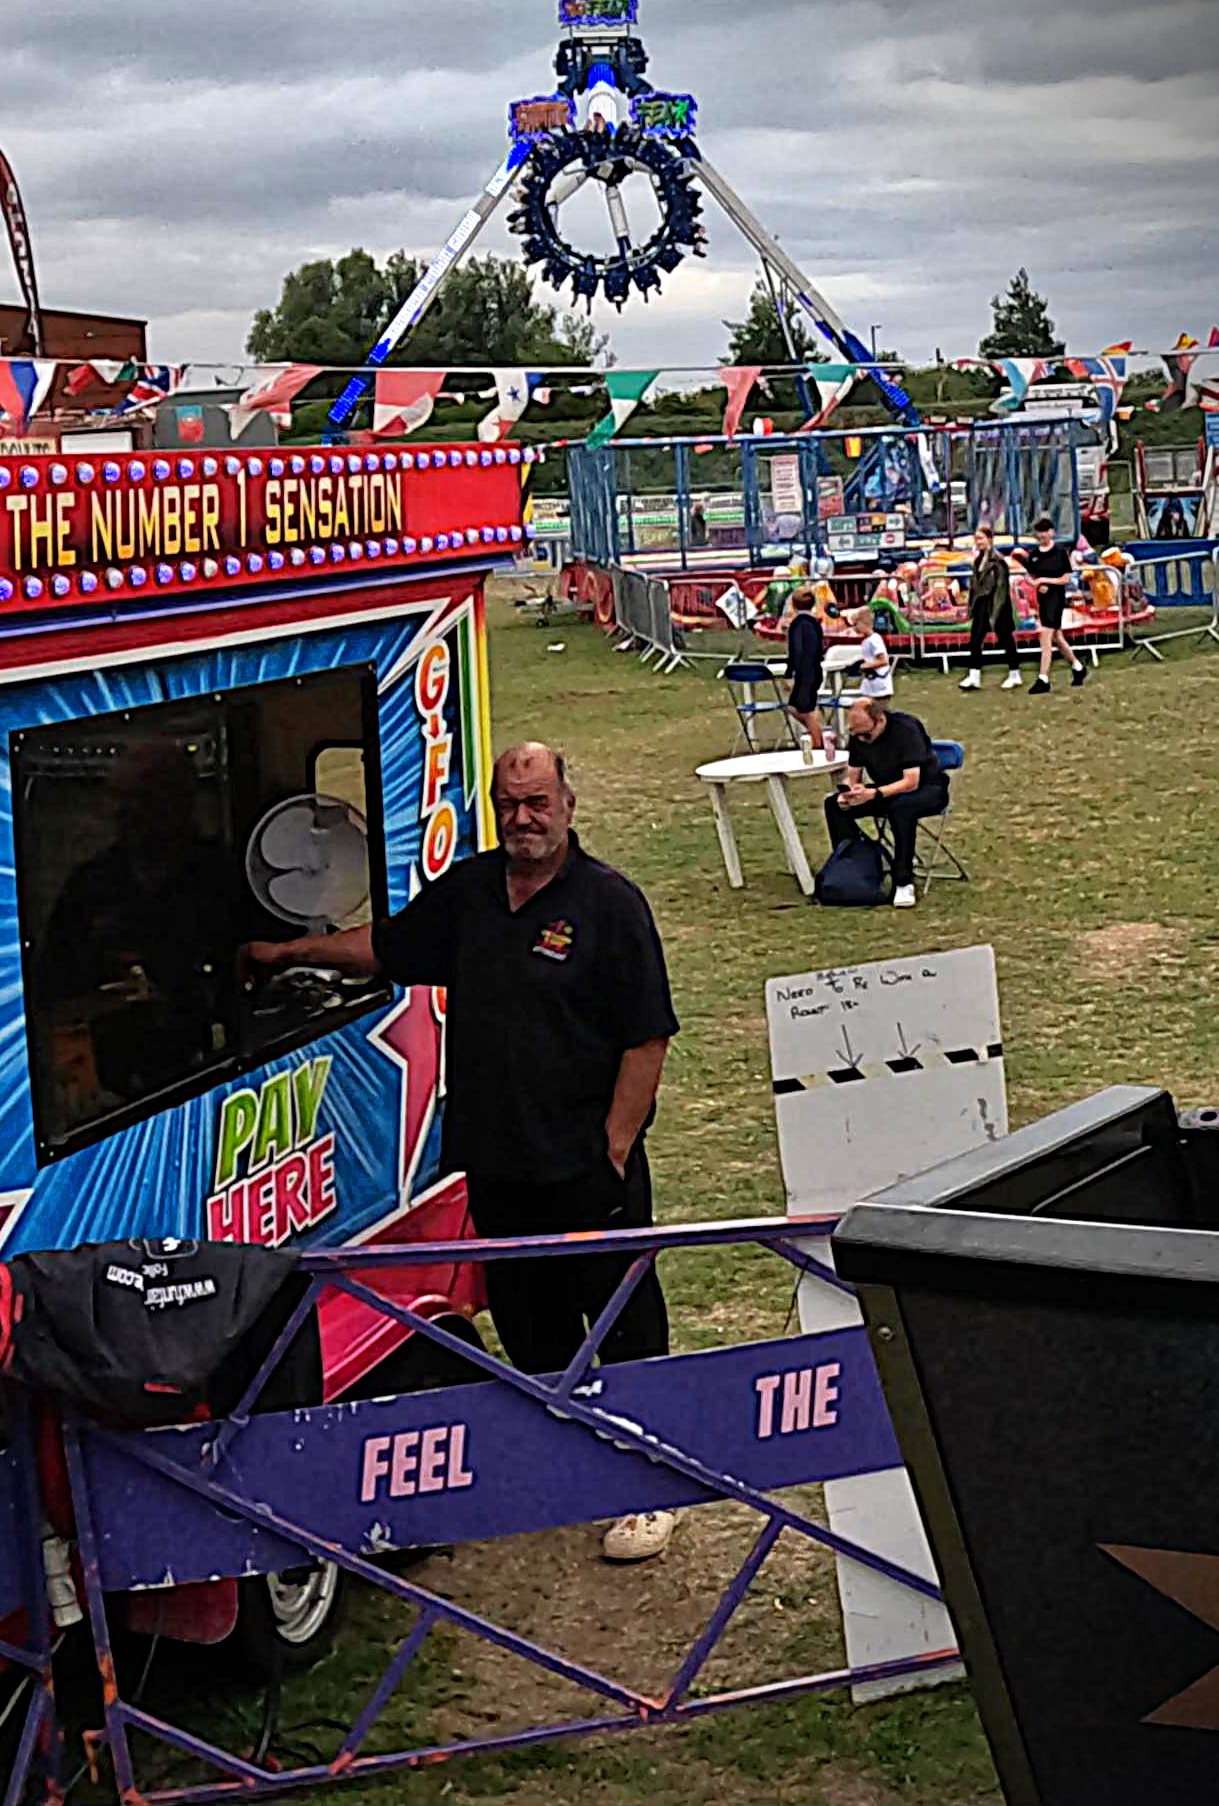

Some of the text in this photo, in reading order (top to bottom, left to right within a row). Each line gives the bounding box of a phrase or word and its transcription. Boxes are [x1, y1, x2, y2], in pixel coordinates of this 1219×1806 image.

[5, 469, 403, 571] THE NUMBER 1 SENSATION
[214, 1055, 334, 1194] PAY
[207, 1131, 337, 1249] HERE
[360, 1361, 843, 1503] FEEL THE
